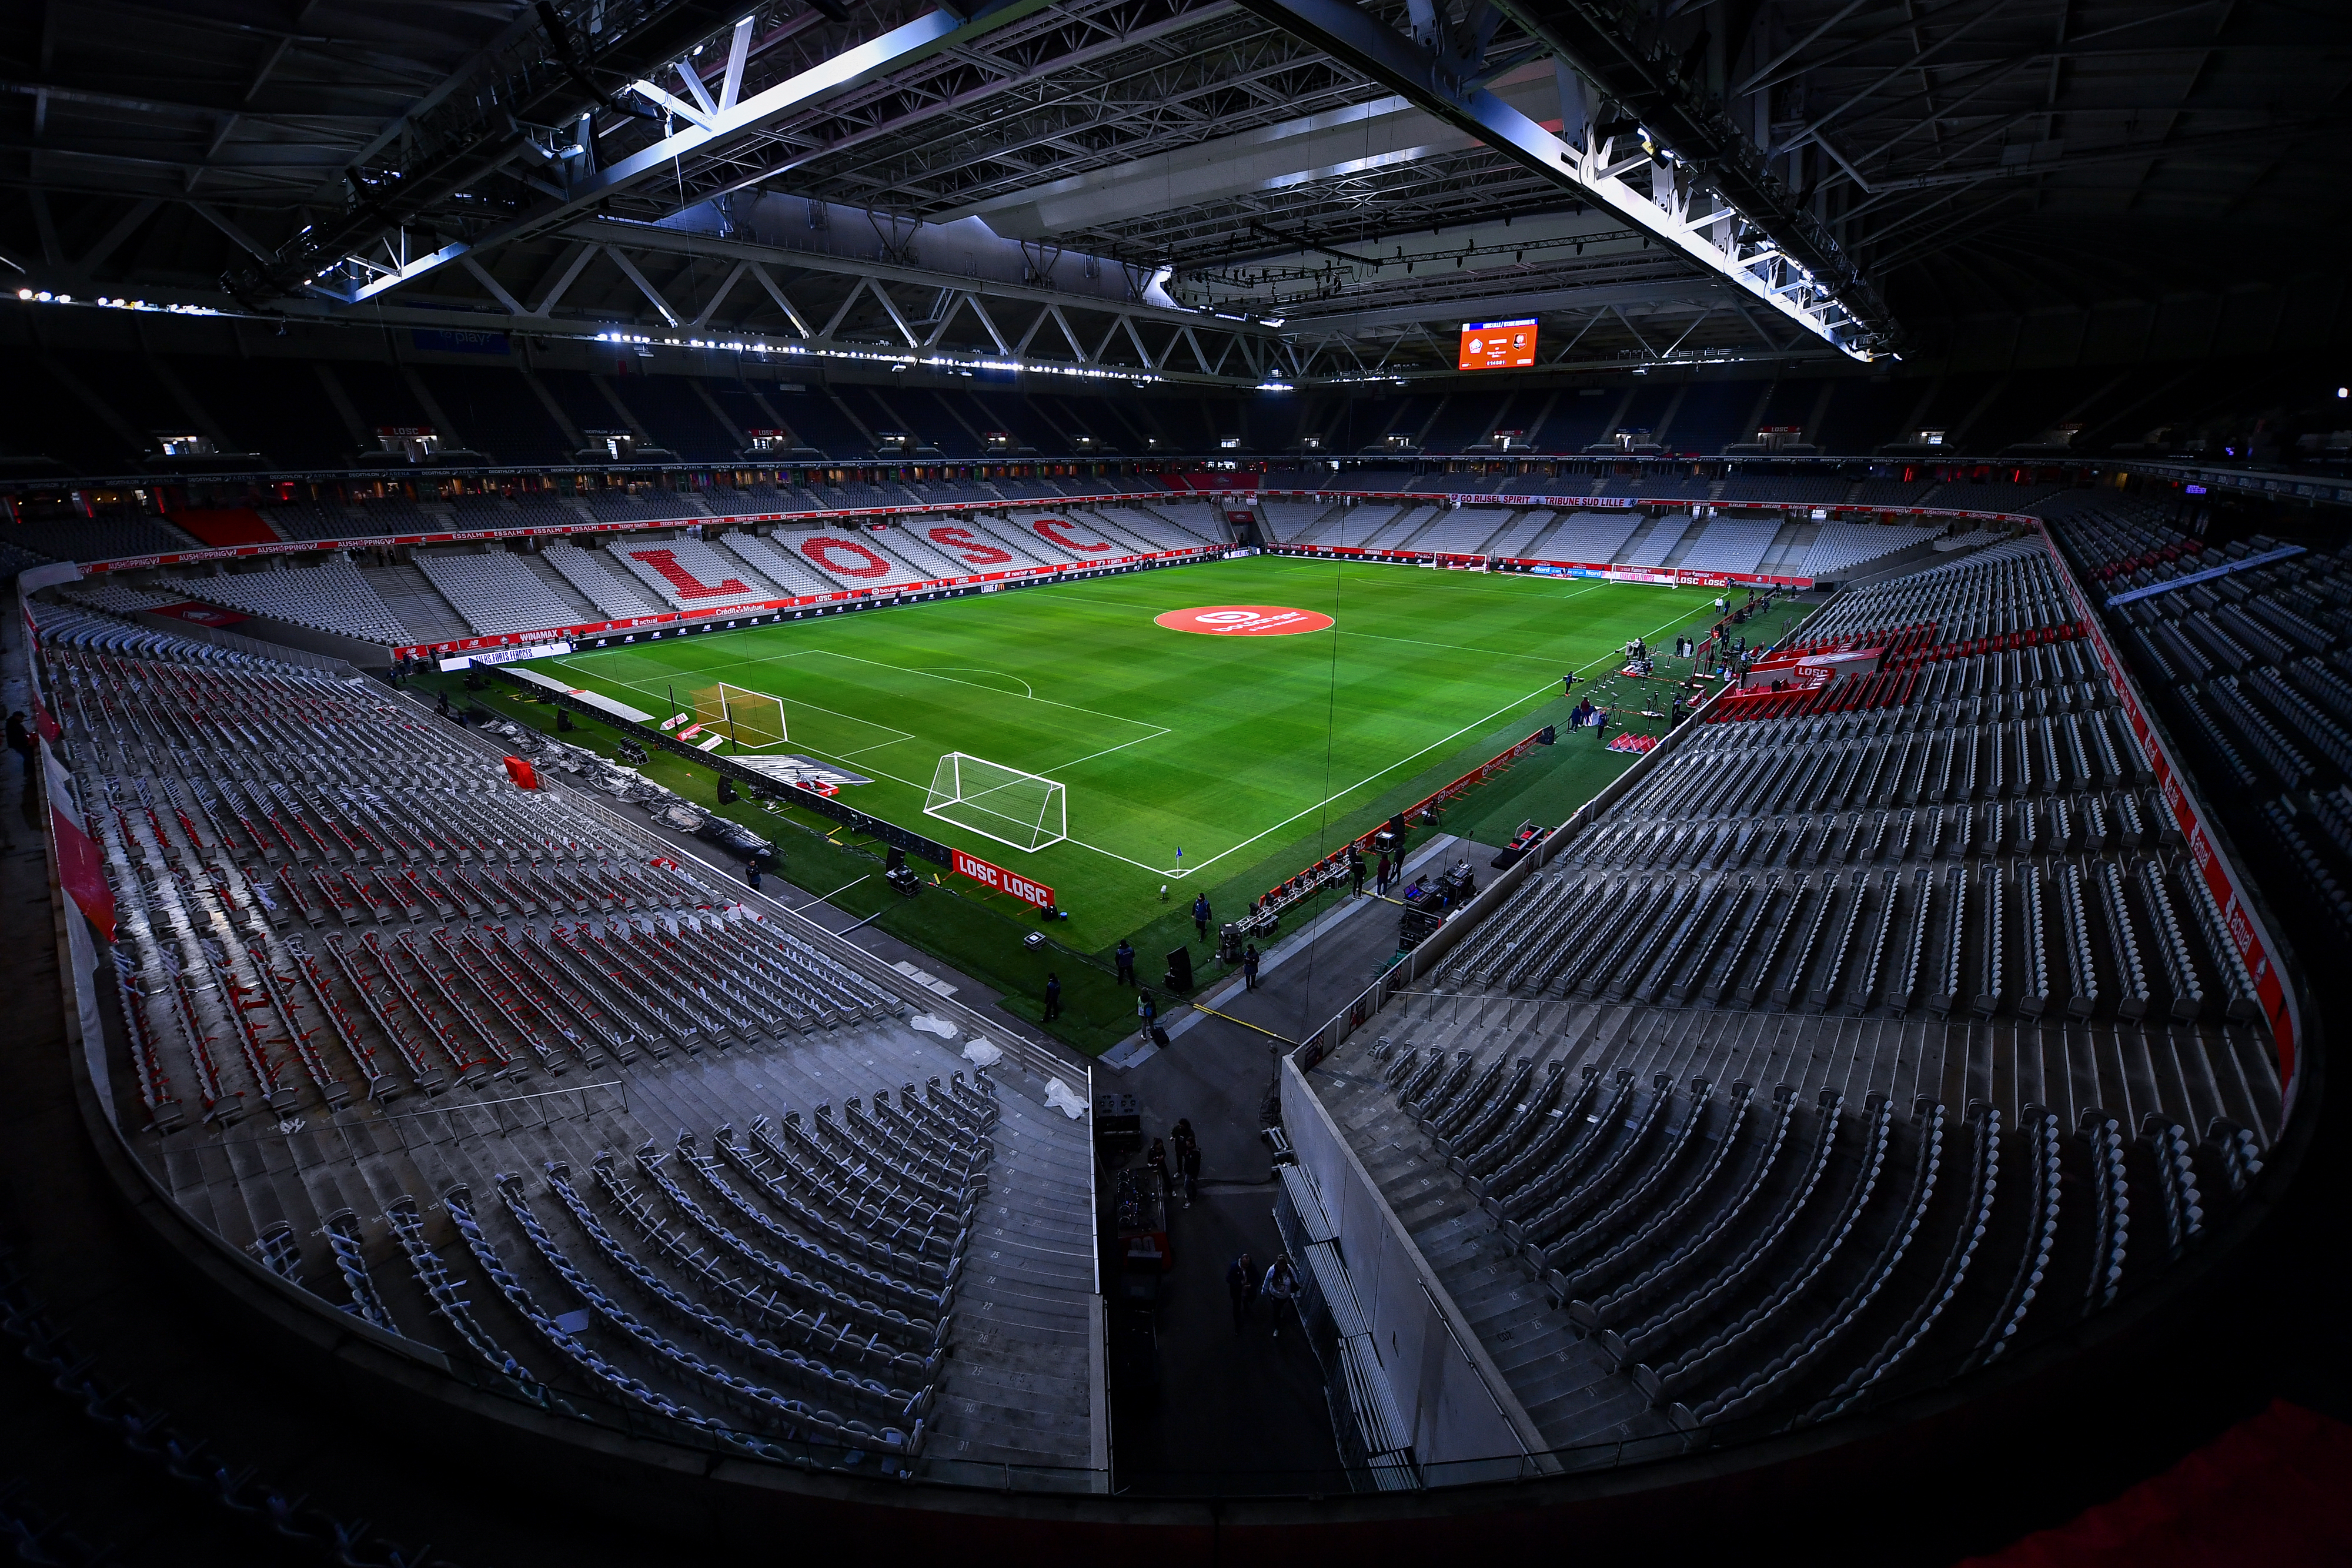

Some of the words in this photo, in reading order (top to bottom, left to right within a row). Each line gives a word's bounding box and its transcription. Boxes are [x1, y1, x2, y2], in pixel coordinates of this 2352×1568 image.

[1474, 495, 1501, 503] RIJSEL
[1503, 496, 1531, 504] SPIRIT
[1545, 496, 1579, 506] TRIBUNE
[1582, 497, 1599, 506] SUD
[1601, 499, 1625, 507] LILLE
[1676, 576, 1699, 584] LOSC
[880, 585, 908, 595] boulanger
[981, 584, 994, 593] LIGUE
[743, 604, 765, 613] Mutuel
[639, 617, 658, 625] actual
[1211, 611, 1301, 631] boulanger
[519, 630, 559, 642] WINAMAX
[1798, 667, 1828, 676] LOSC
[1488, 754, 1509, 771] boulanger
[1445, 778, 1471, 797] boulanger
[2194, 836, 2211, 871] actual
[959, 855, 997, 885] LOSC
[1003, 874, 1048, 907] LOSC
[2231, 911, 2254, 956] actual
[987, 1275, 997, 1283] 26
[983, 1302, 993, 1310] 27
[978, 1333, 988, 1343] 28
[1557, 1352, 1569, 1362] 30
[973, 1366, 983, 1376] 29
[1585, 1386, 1597, 1397] 31
[965, 1403, 975, 1413] 30
[958, 1440, 970, 1451] 31
